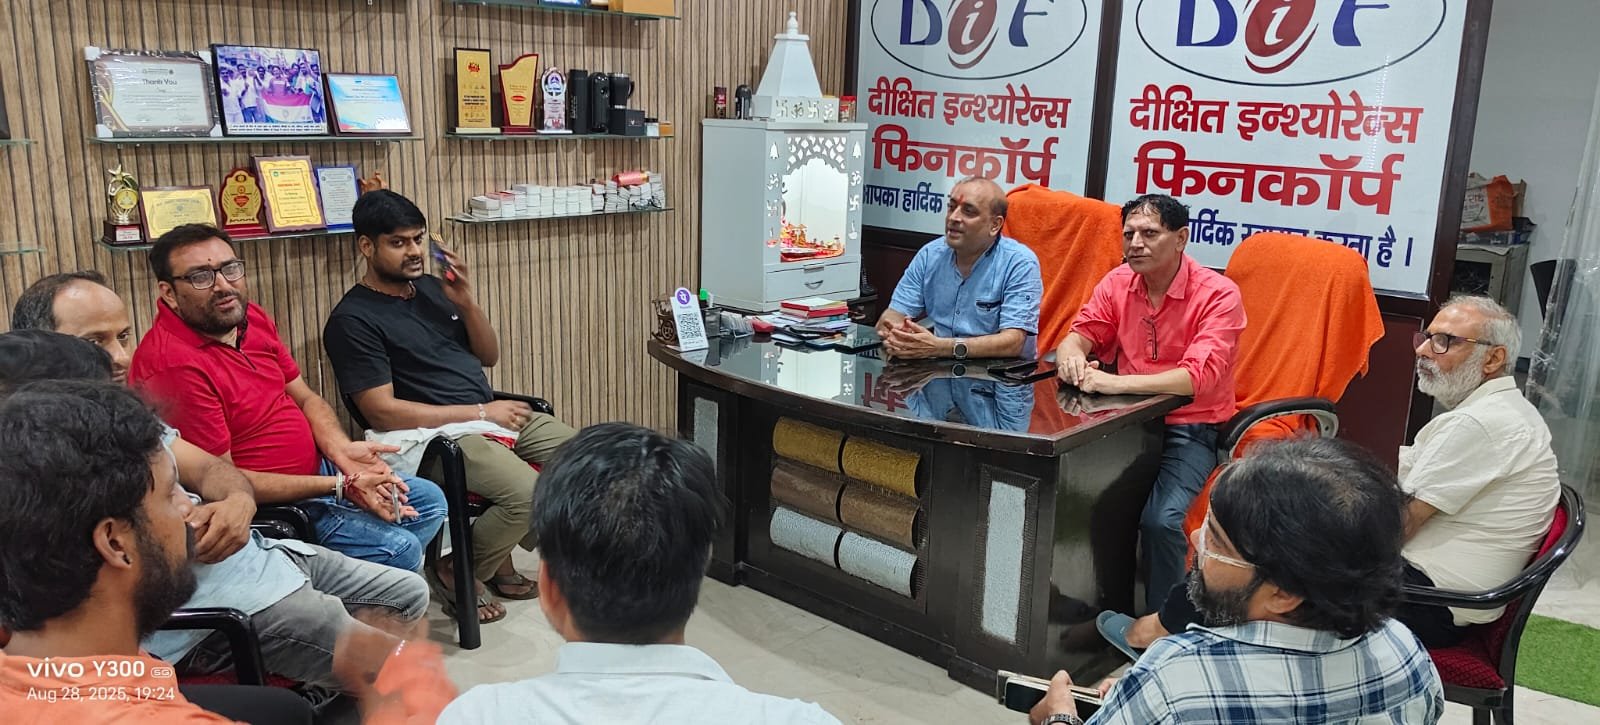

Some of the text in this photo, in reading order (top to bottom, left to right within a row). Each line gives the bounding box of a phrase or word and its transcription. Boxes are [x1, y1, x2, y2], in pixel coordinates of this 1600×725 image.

[868, 76, 1072, 128] दीक्षित इन्श्योरेन्स
[1129, 84, 1424, 144] दीक्षित इन्श्योरेन्स
[872, 124, 1059, 187] फिनकॉर्प
[1134, 140, 1405, 216] फिनकॉर्प
[902, 182, 945, 213] हार्दिक
[1188, 208, 1238, 246] ार्दिक
[1376, 225, 1396, 268] है
